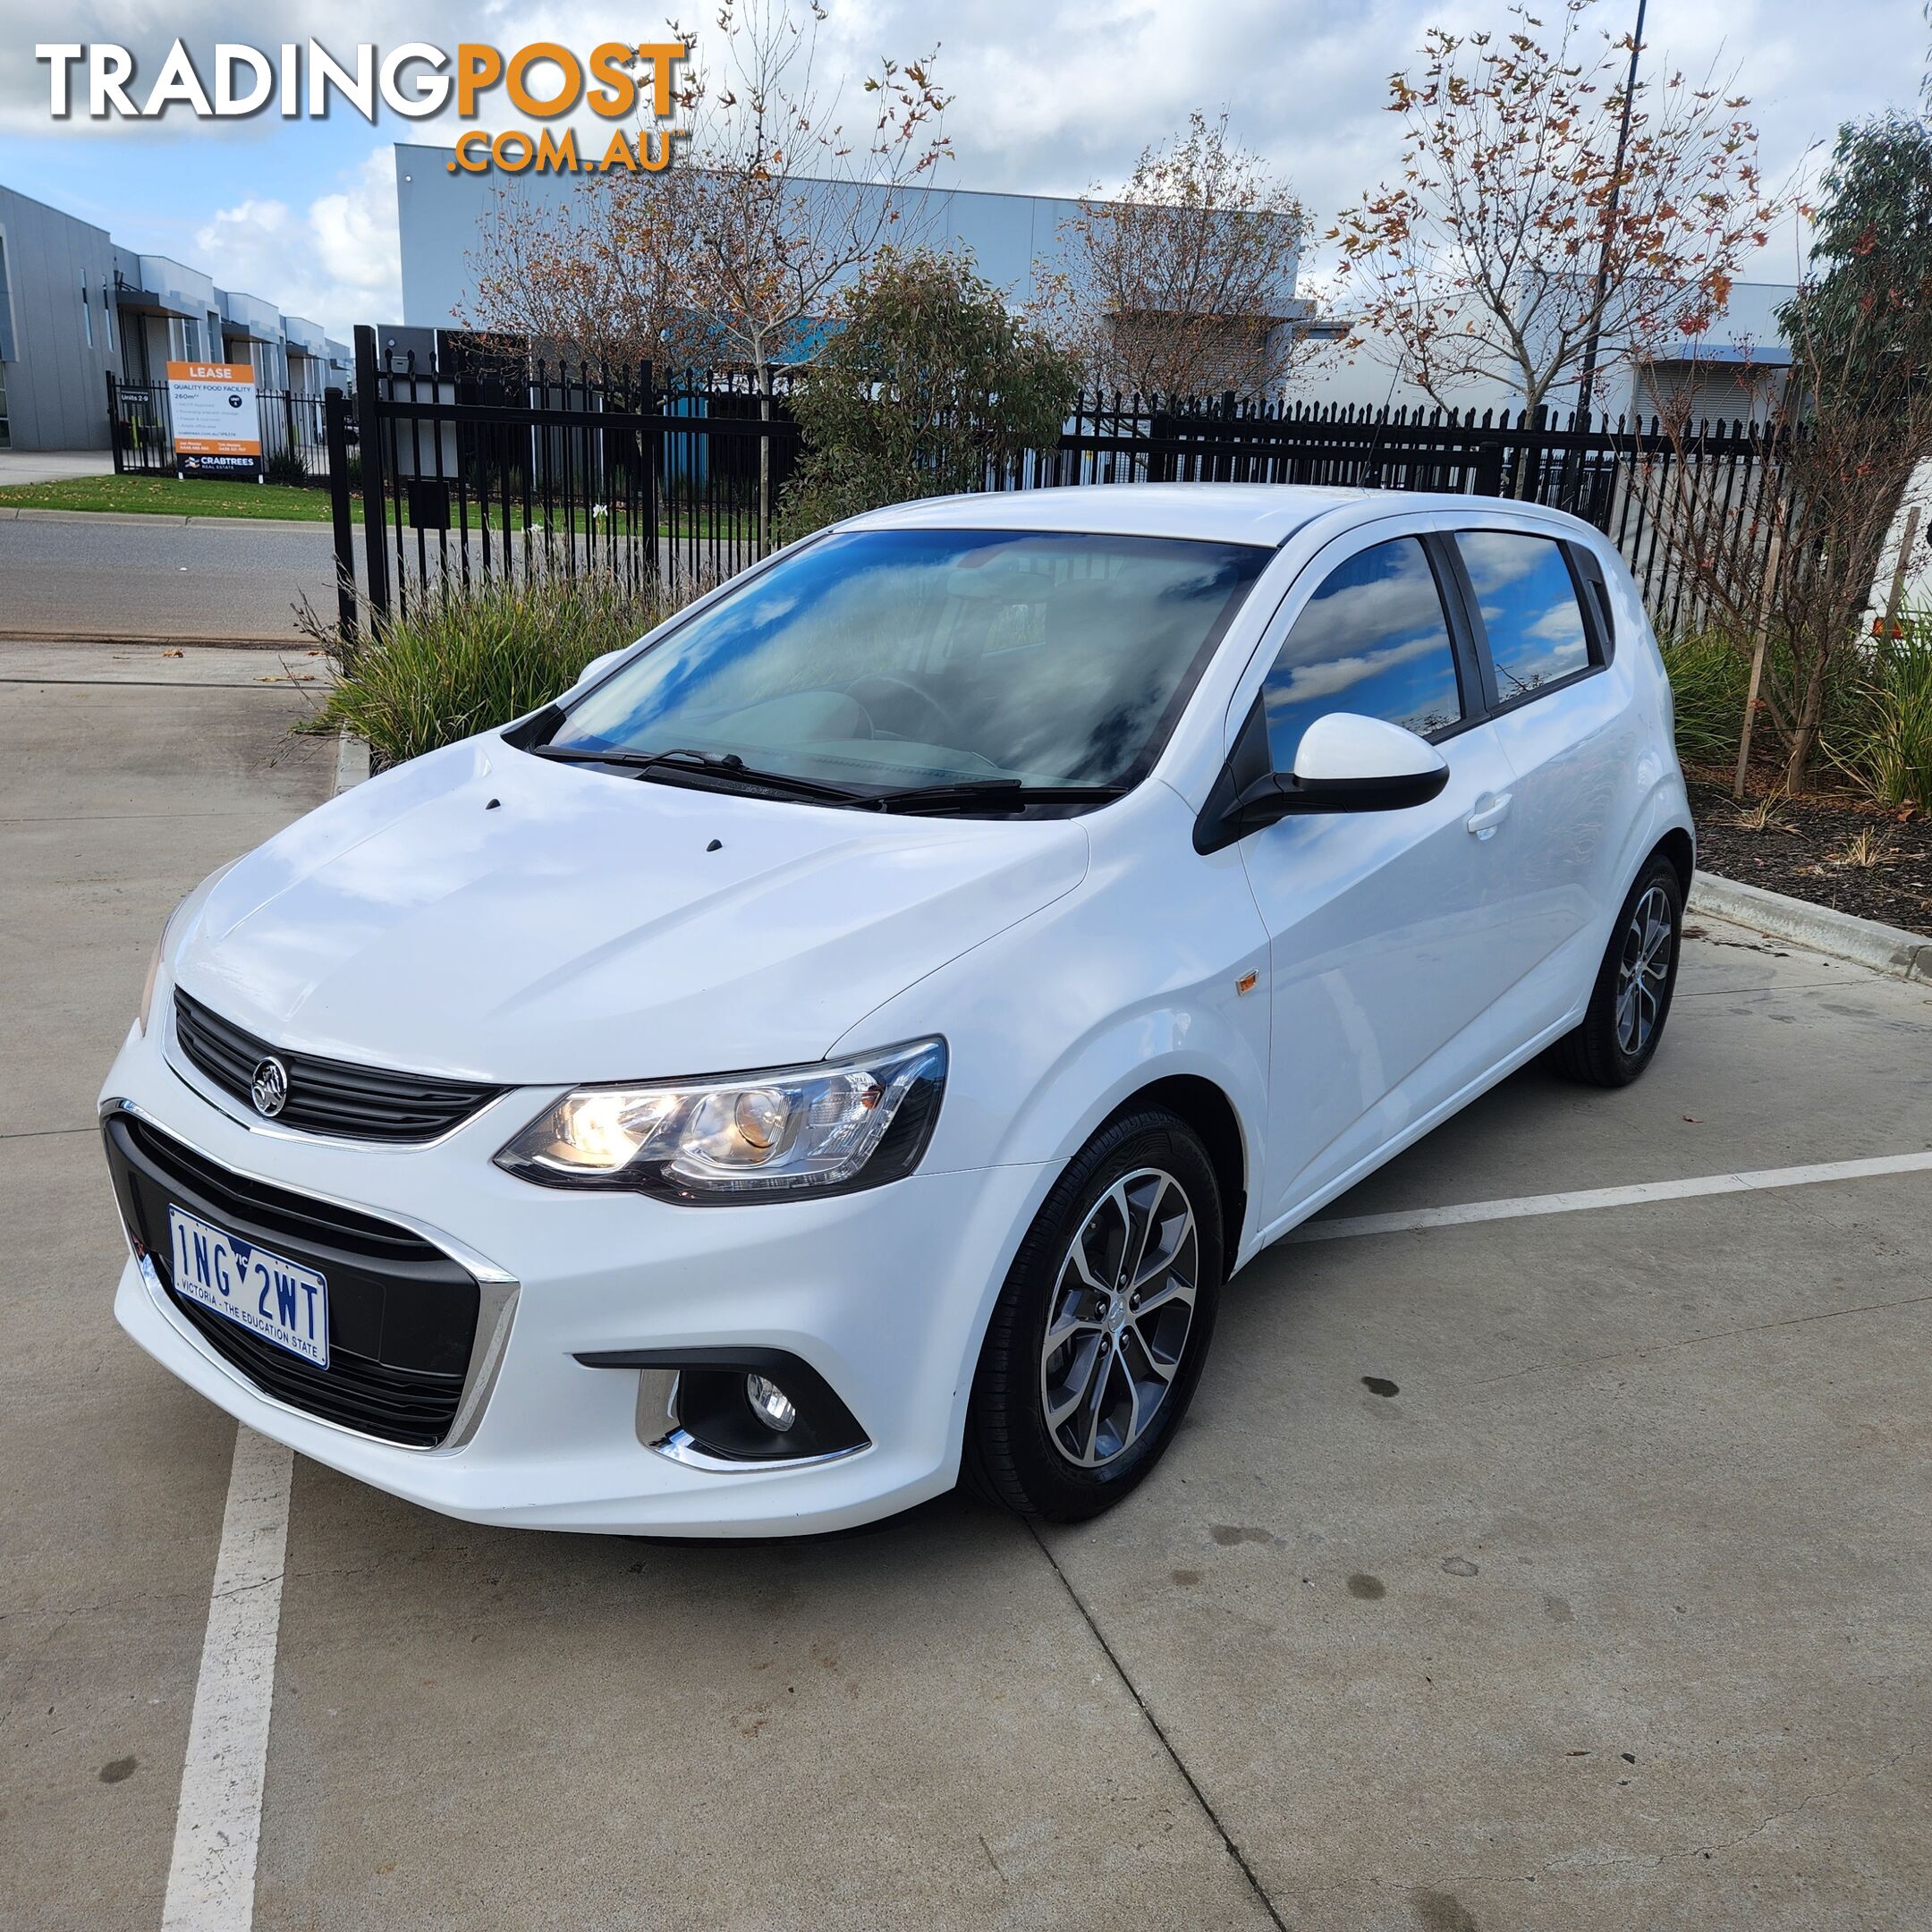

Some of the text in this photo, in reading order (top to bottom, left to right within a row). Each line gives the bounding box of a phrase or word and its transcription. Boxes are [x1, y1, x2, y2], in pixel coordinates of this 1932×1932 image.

[189, 367, 233, 379] LEASE
[200, 456, 254, 466] CRABTREES
[235, 1253, 250, 1267] VIC
[178, 1224, 318, 1341] 1NG 2WT
[182, 1278, 217, 1307] VICTORIA
[224, 1301, 241, 1319] THE
[242, 1309, 290, 1343] EDUCATION
[292, 1335, 318, 1359] STATE
